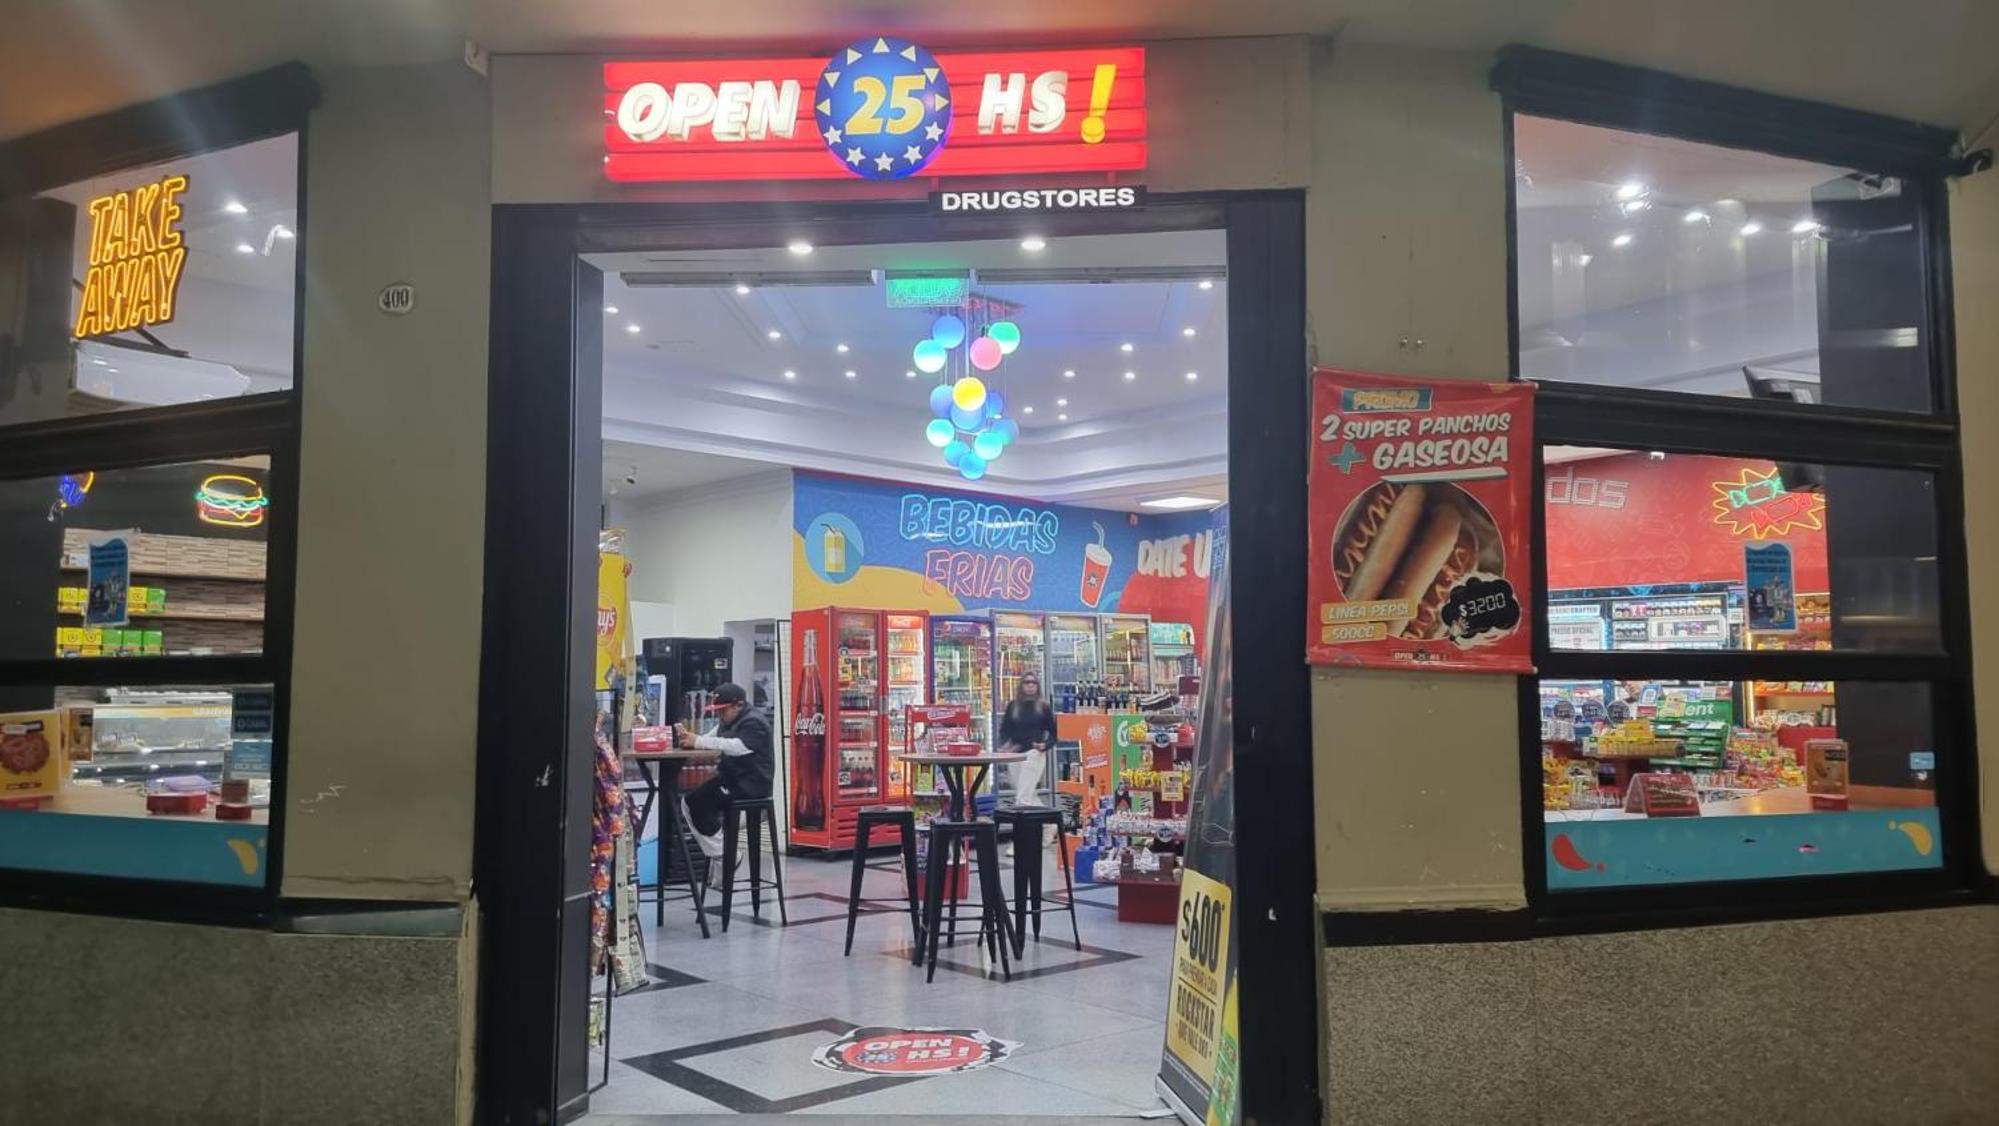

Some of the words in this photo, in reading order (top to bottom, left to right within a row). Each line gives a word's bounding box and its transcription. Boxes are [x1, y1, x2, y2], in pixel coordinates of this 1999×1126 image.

[616, 79, 801, 142] OPEN
[845, 75, 927, 135] 25
[977, 70, 1069, 135] HS
[1081, 64, 1117, 144] !
[941, 188, 1135, 211] DRUGSTORES
[89, 176, 186, 266] TAKE
[75, 247, 185, 338] AWAY
[382, 287, 409, 309] 400
[1320, 413, 1341, 441] 2
[1342, 419, 1412, 441] SUPER
[1418, 412, 1512, 436] PANCHOS
[1372, 435, 1509, 470] GASEOSA
[1545, 466, 1630, 510] dos
[899, 493, 1059, 555] BEBIDAS
[922, 549, 1035, 601] FRIAS
[1137, 533, 1191, 578] DATE
[1328, 605, 1366, 620] LINEA
[864, 1038, 953, 1051] OPEN
[907, 1048, 953, 1060] HS
